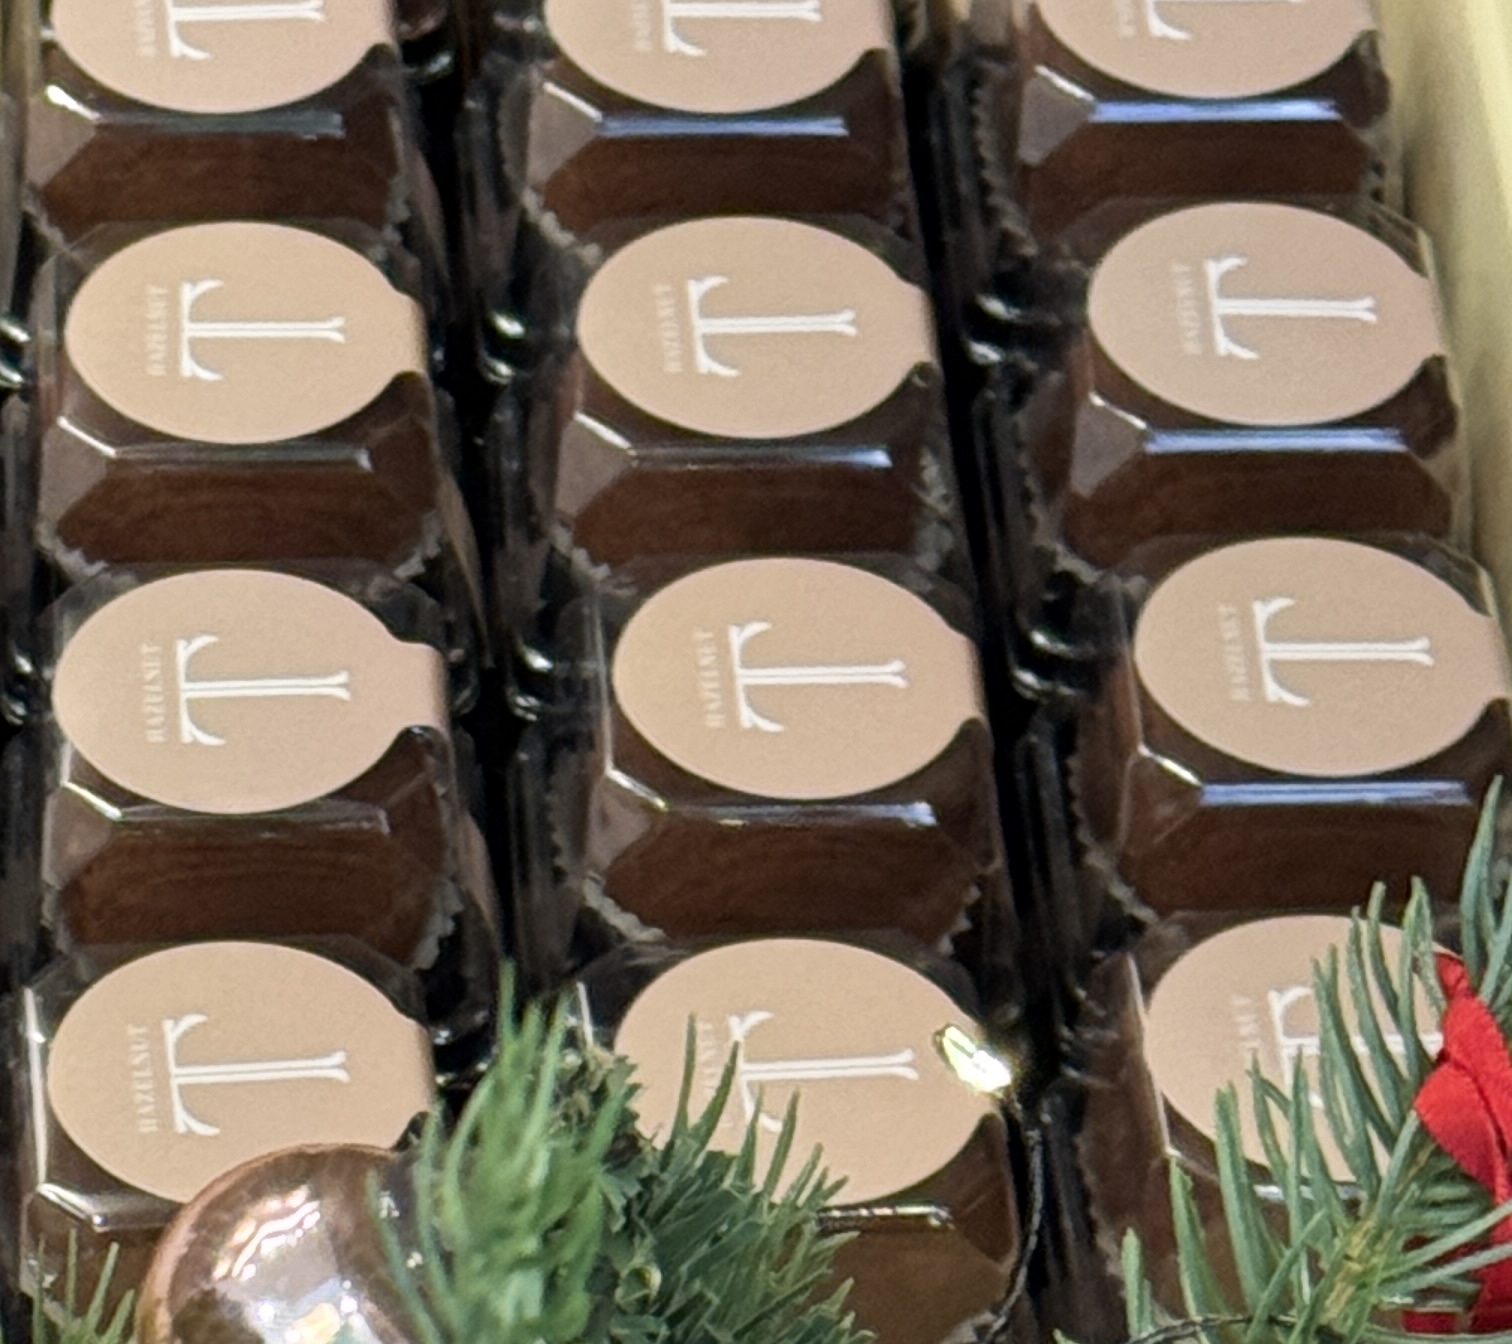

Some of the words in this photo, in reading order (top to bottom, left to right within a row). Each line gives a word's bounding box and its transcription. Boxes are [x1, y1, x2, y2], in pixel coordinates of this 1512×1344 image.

[180, 280, 346, 380] T
[688, 275, 856, 376] T
[1206, 257, 1377, 359] T
[175, 635, 351, 746] T
[730, 622, 908, 732] T
[1252, 597, 1434, 706] T
[128, 1023, 159, 1134] HAZELNUT
[163, 1014, 349, 1135] T
[729, 1011, 919, 1133] T
